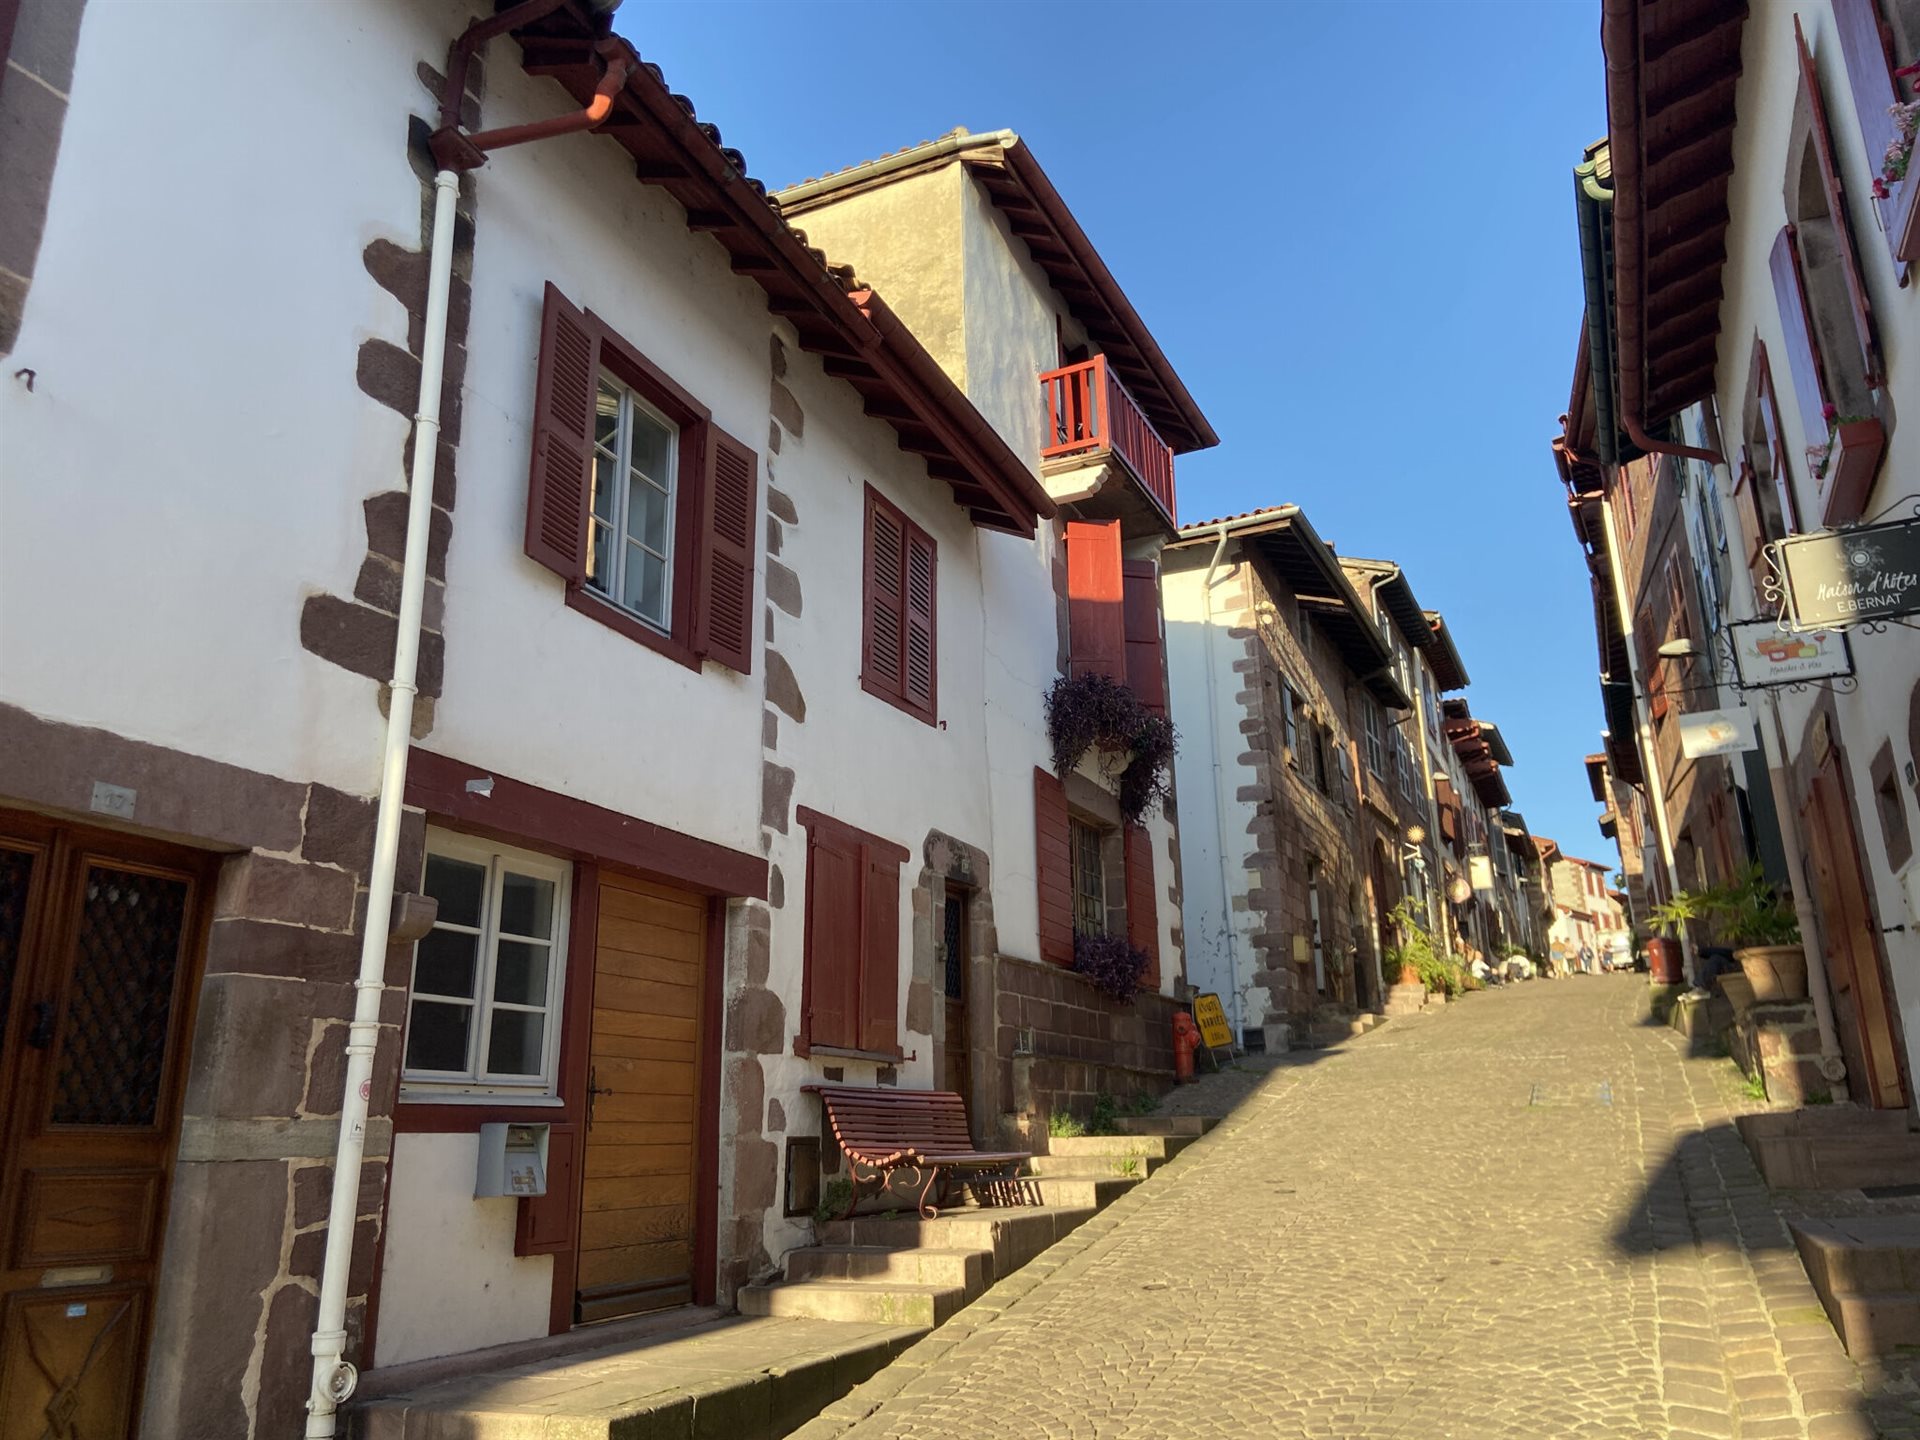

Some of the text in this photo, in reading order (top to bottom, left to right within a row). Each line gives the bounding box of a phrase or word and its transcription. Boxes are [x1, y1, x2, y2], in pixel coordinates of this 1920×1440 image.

[1817, 571, 1917, 601] Maison d'hôtes
[1837, 593, 1902, 612] E.BERNAT
